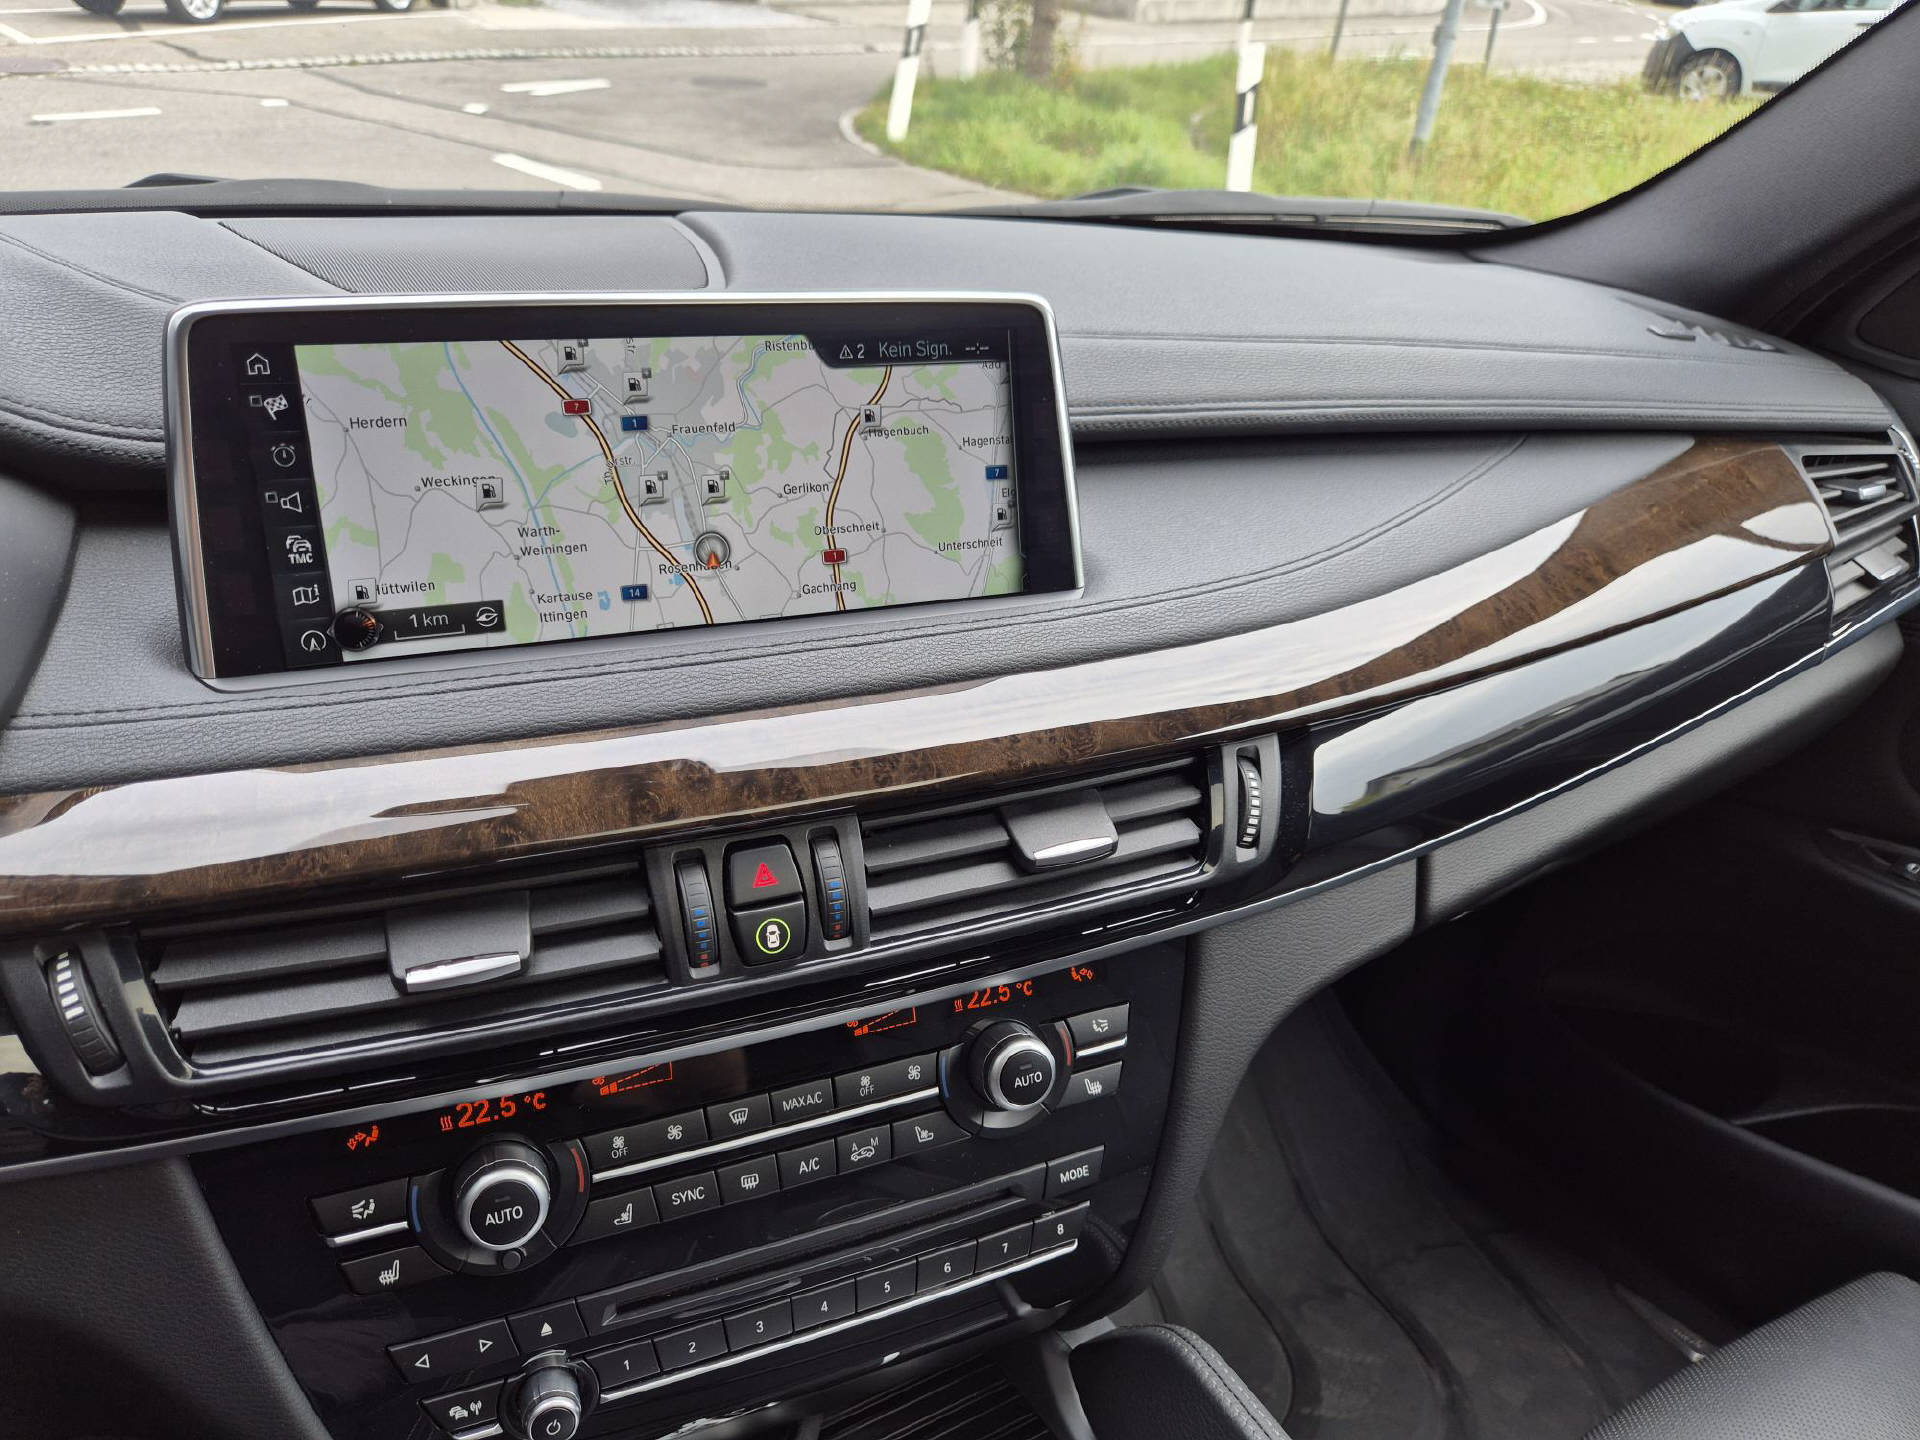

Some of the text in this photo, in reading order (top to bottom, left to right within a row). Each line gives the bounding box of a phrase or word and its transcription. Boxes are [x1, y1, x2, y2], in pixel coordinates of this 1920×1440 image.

[857, 344, 865, 359] 2
[879, 343, 912, 359] Kein
[916, 341, 952, 359] Sign.
[349, 416, 407, 430] Herdern
[671, 421, 736, 434] Frauenfeld
[868, 425, 929, 440] Hagenbuch
[783, 482, 829, 495] Gerlikon
[517, 526, 560, 538] Warth-
[814, 521, 880, 535] Oberschneit
[520, 543, 588, 556] Weiningen
[938, 537, 1003, 551] Unterschneit
[288, 553, 313, 565] TMC
[628, 588, 641, 599] 14
[802, 580, 857, 595] Gachnang
[537, 591, 593, 604] Kartause
[409, 612, 449, 628] 1 km
[539, 610, 588, 623] Ittingen
[968, 984, 1011, 1009] 22.5
[1014, 1072, 1043, 1089] AUTO
[860, 1084, 875, 1097] OFF
[456, 1095, 517, 1128] 22.5
[611, 1147, 629, 1158] OFF
[799, 1157, 821, 1174] A/C
[1060, 1165, 1090, 1184] MODE
[672, 1186, 705, 1205] SYNC
[485, 1205, 524, 1227] AUTO
[1057, 1223, 1064, 1235] 8
[1002, 1242, 1008, 1254] 7
[944, 1262, 951, 1274] 6
[884, 1281, 891, 1293] 5
[820, 1300, 829, 1313] 4
[756, 1320, 764, 1334] 3
[688, 1341, 696, 1354] 2
[623, 1359, 630, 1371] 1
